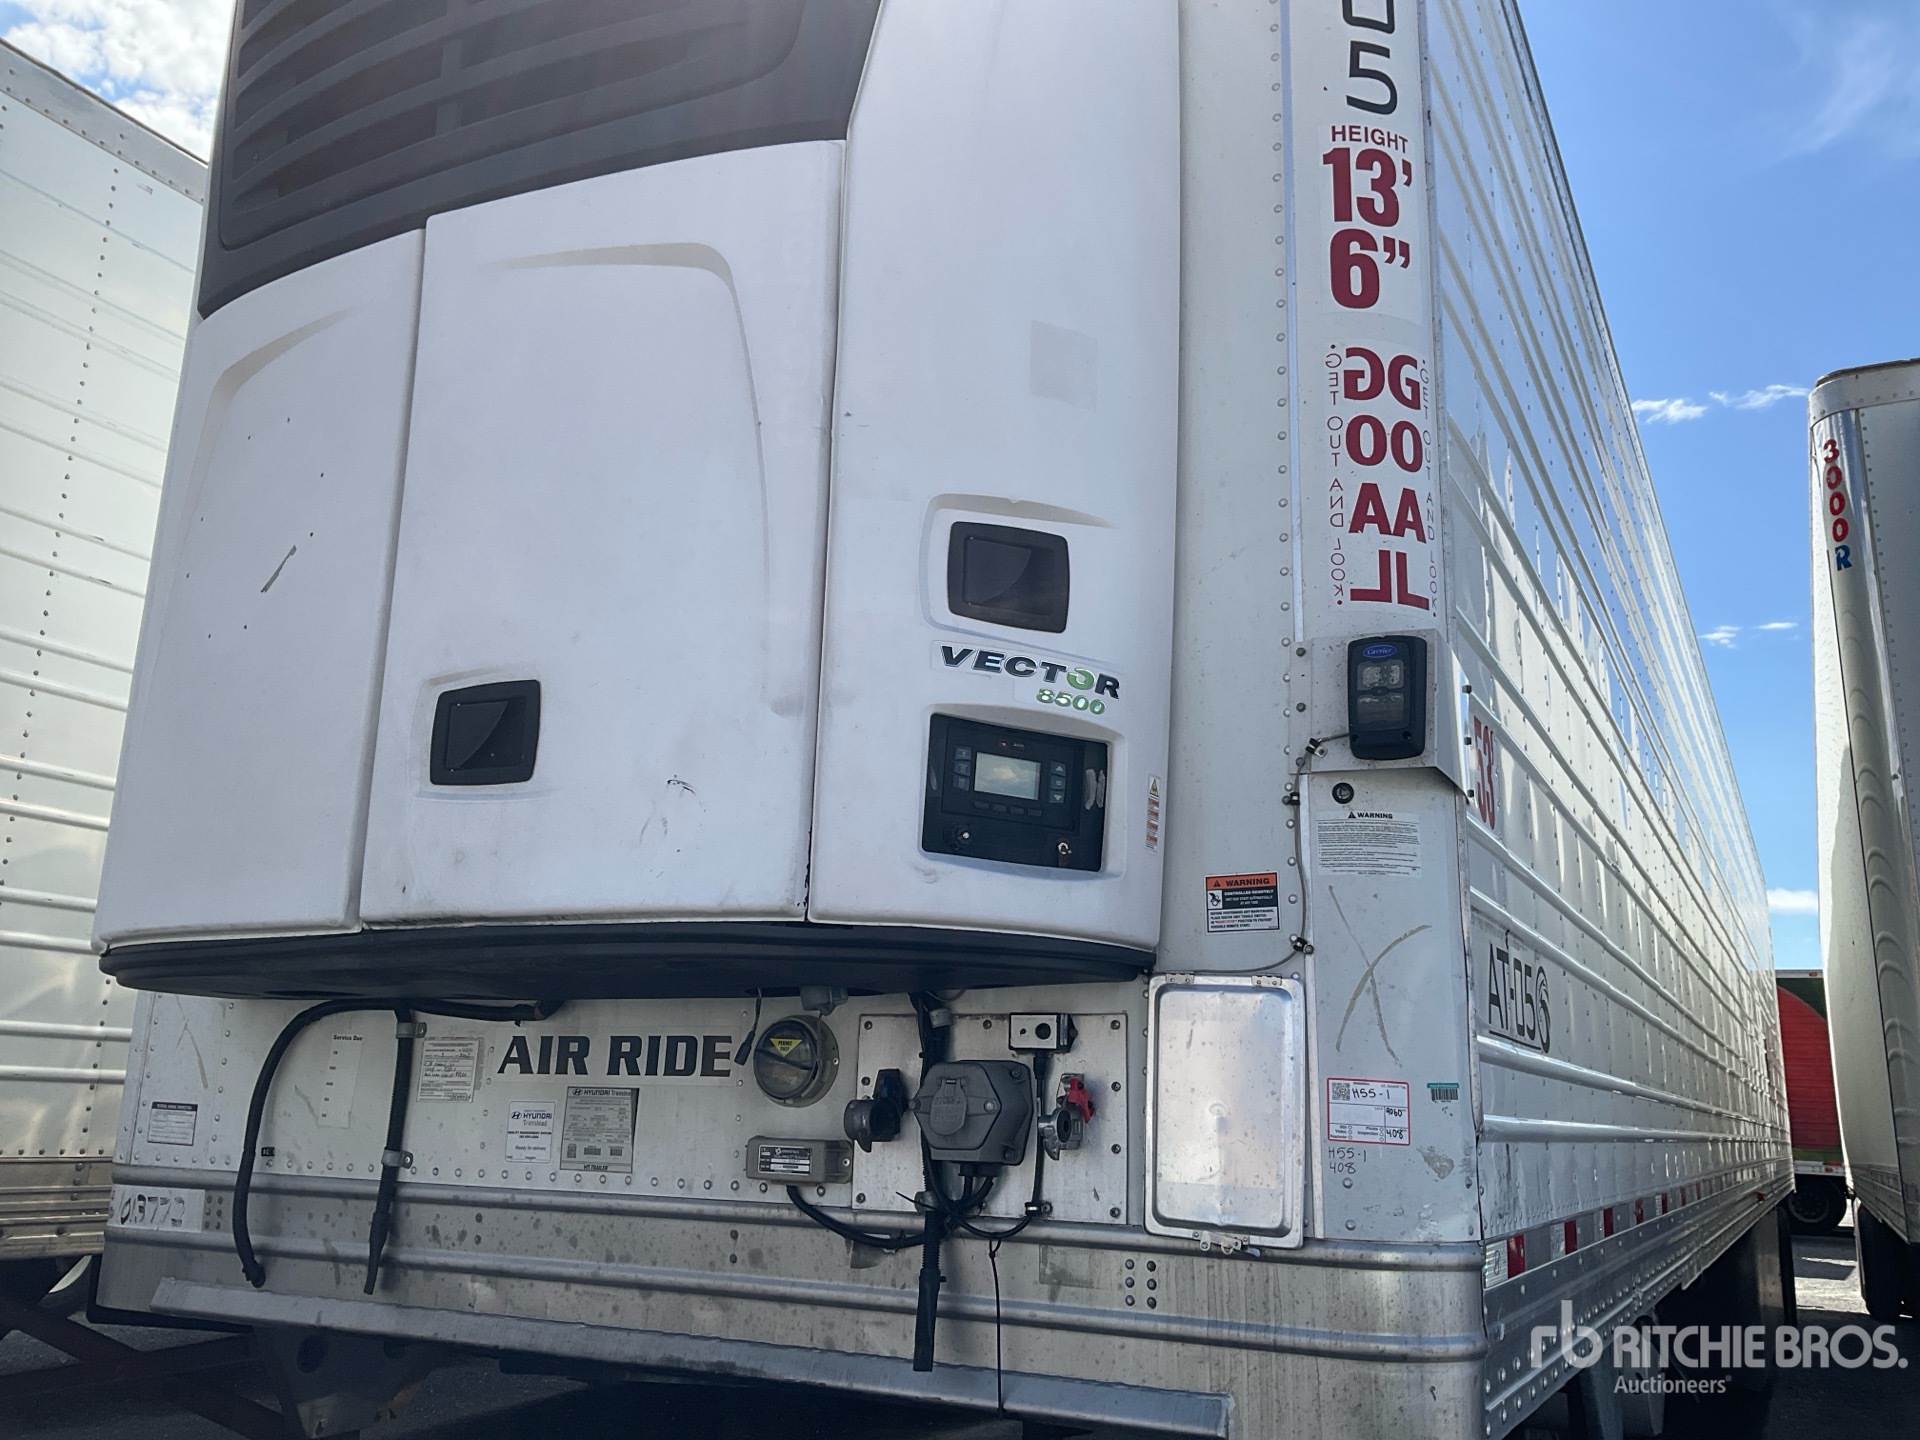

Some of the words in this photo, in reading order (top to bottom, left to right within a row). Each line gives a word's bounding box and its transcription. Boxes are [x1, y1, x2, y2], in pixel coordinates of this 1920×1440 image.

[1331, 125, 1409, 154] HEIGHT
[1322, 147, 1413, 228] 13'
[1420, 368, 1429, 420] GET
[1423, 430, 1431, 480] OUT
[1387, 354, 1430, 611] GOAL
[1823, 438, 1852, 571] 3000R
[1426, 492, 1434, 540] AND
[1429, 550, 1437, 610] LOOK
[940, 645, 1120, 699] VECTOR
[1366, 647, 1393, 655] Carrier
[1036, 687, 1106, 715] 8500
[1225, 877, 1270, 887] WARNING
[497, 1035, 591, 1075] AIR
[606, 1035, 732, 1077] RIDE
[523, 1119, 547, 1127] Translead
[1386, 1129, 1404, 1140] 408
[1329, 1161, 1356, 1174] 408
